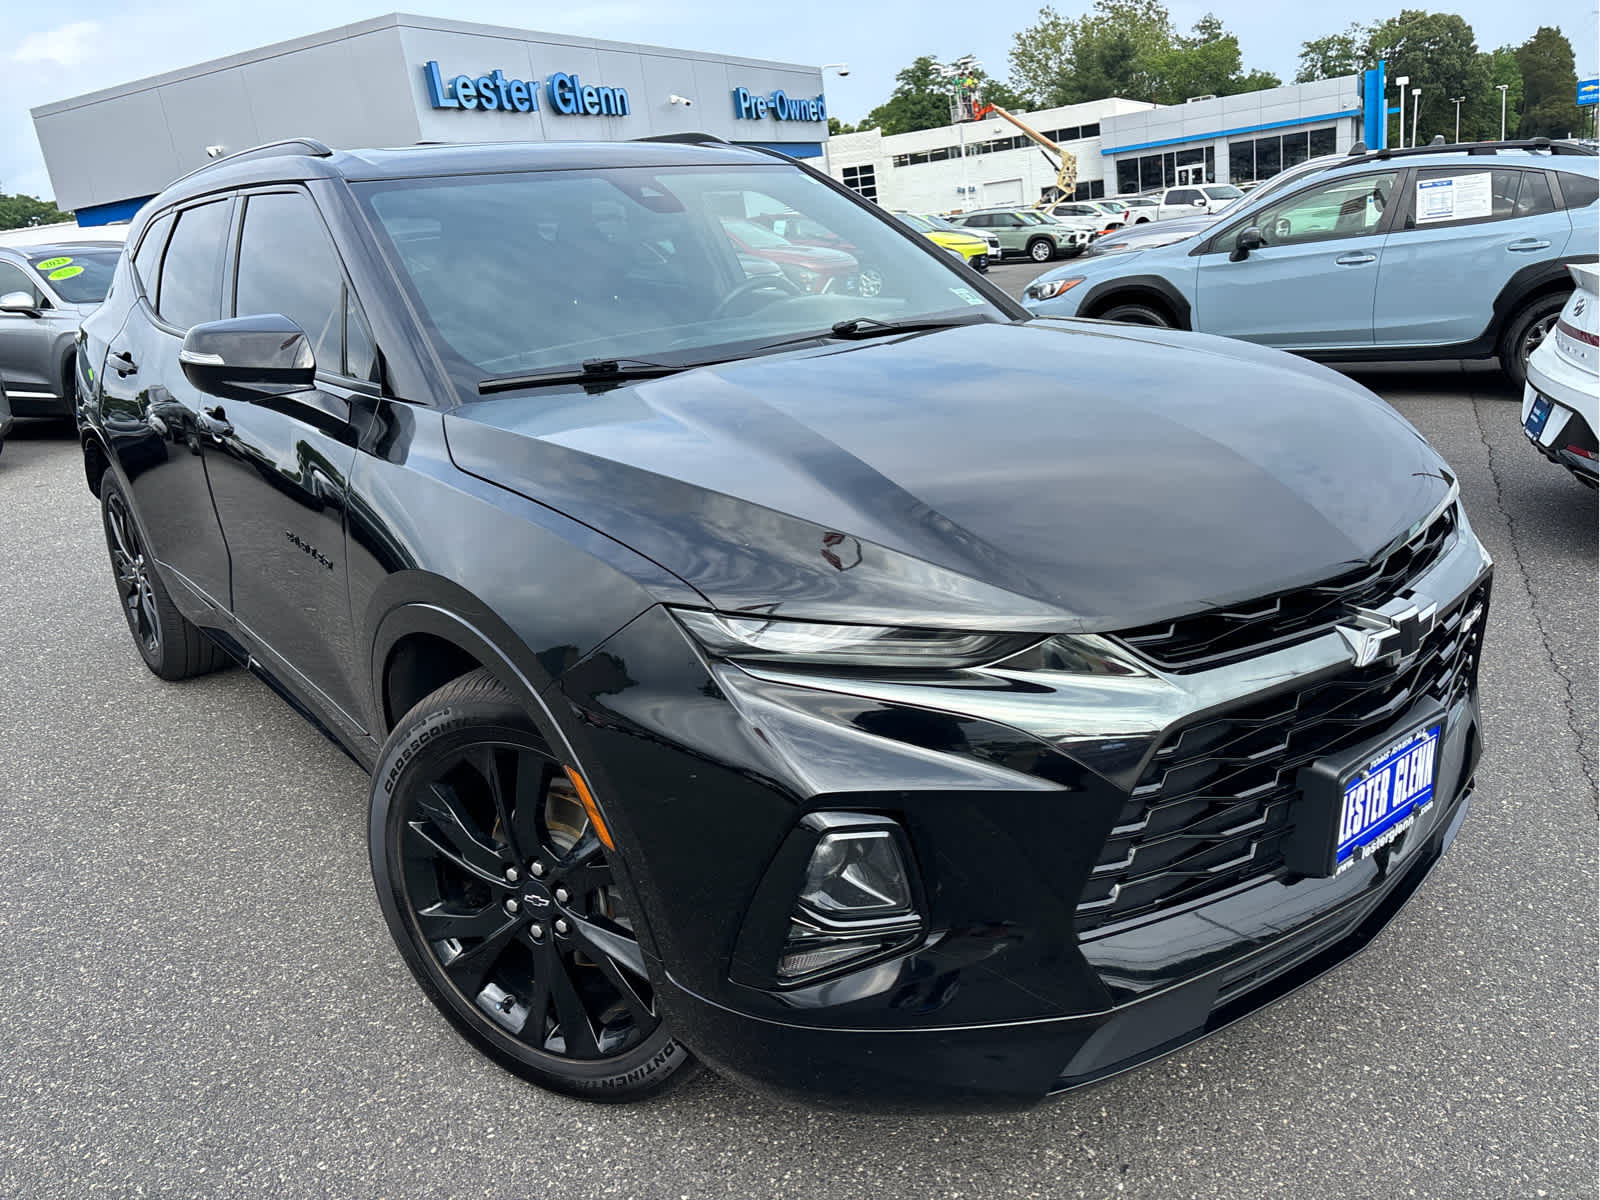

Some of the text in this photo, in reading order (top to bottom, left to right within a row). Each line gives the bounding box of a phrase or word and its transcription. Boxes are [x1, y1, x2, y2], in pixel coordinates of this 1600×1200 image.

[424, 60, 630, 116] Lester Glenn
[732, 86, 826, 121] Pre-Owned
[1337, 767, 1391, 846] LESTER
[1393, 738, 1437, 808] GLENN
